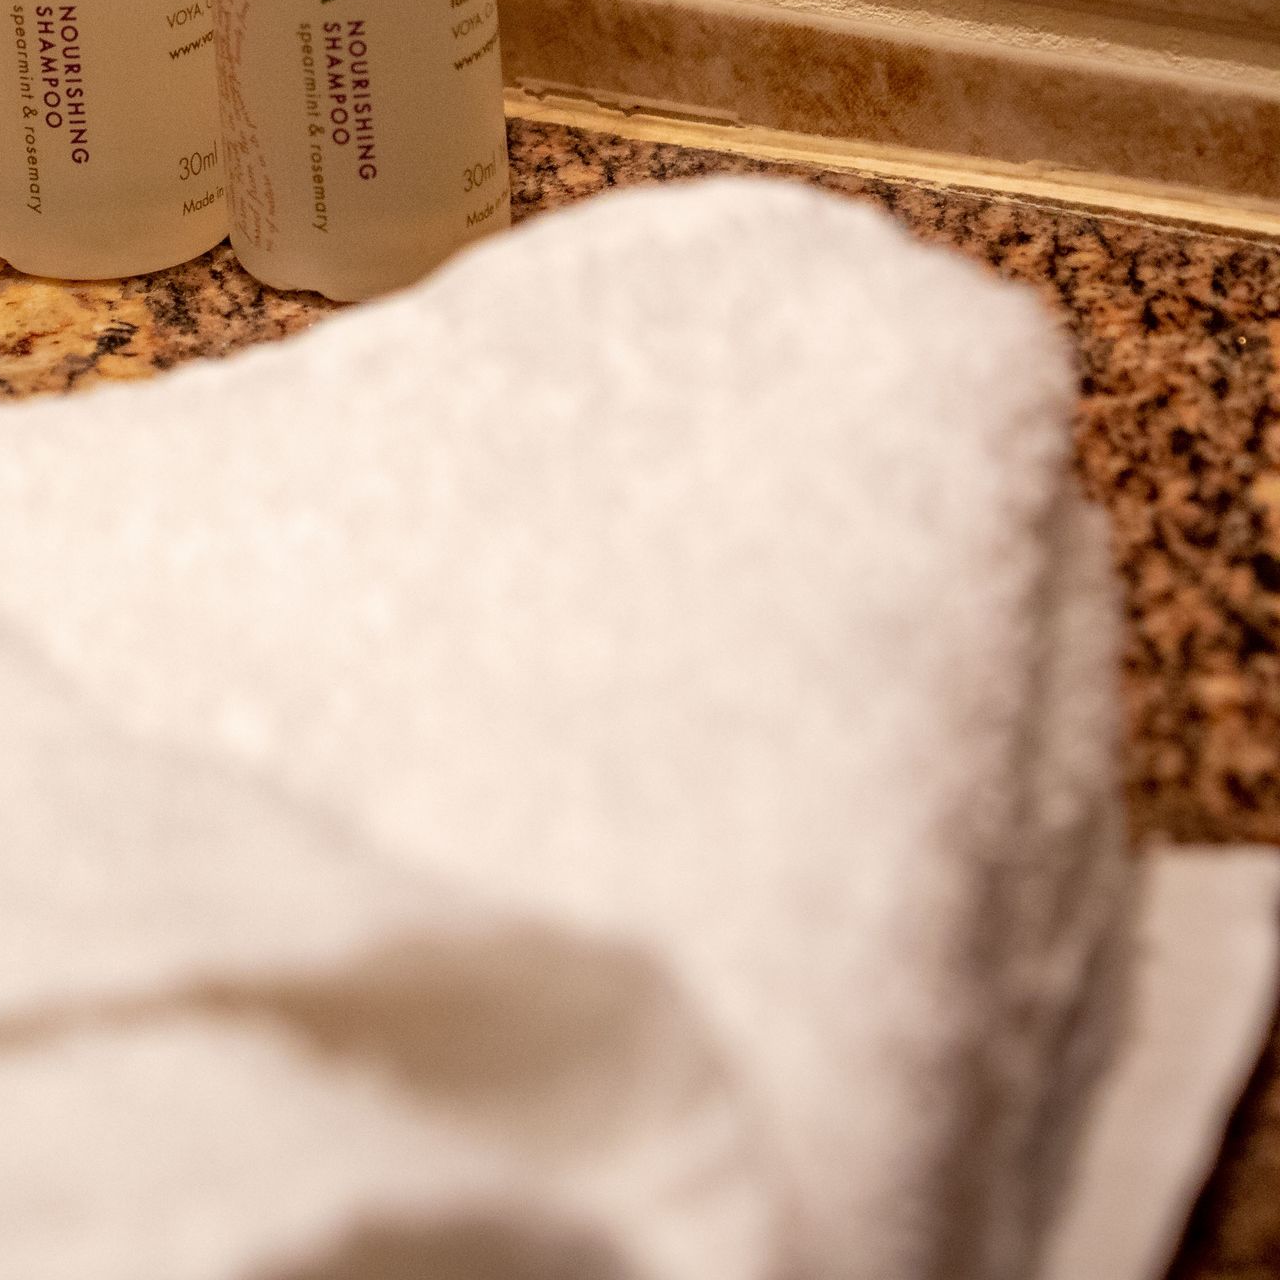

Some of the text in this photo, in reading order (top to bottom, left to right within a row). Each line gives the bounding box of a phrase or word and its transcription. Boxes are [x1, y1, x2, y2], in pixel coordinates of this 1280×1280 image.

[10, 5, 42, 215] spearmint & rosemary
[36, 6, 63, 129] SHAMPOO
[59, 5, 90, 165] NOURISHING
[296, 22, 329, 234] spearmint & rosemary
[322, 22, 350, 146] SHAMPOO
[347, 20, 377, 180] NOURISHING
[179, 139, 218, 181] 30ml
[183, 190, 215, 216] Made
